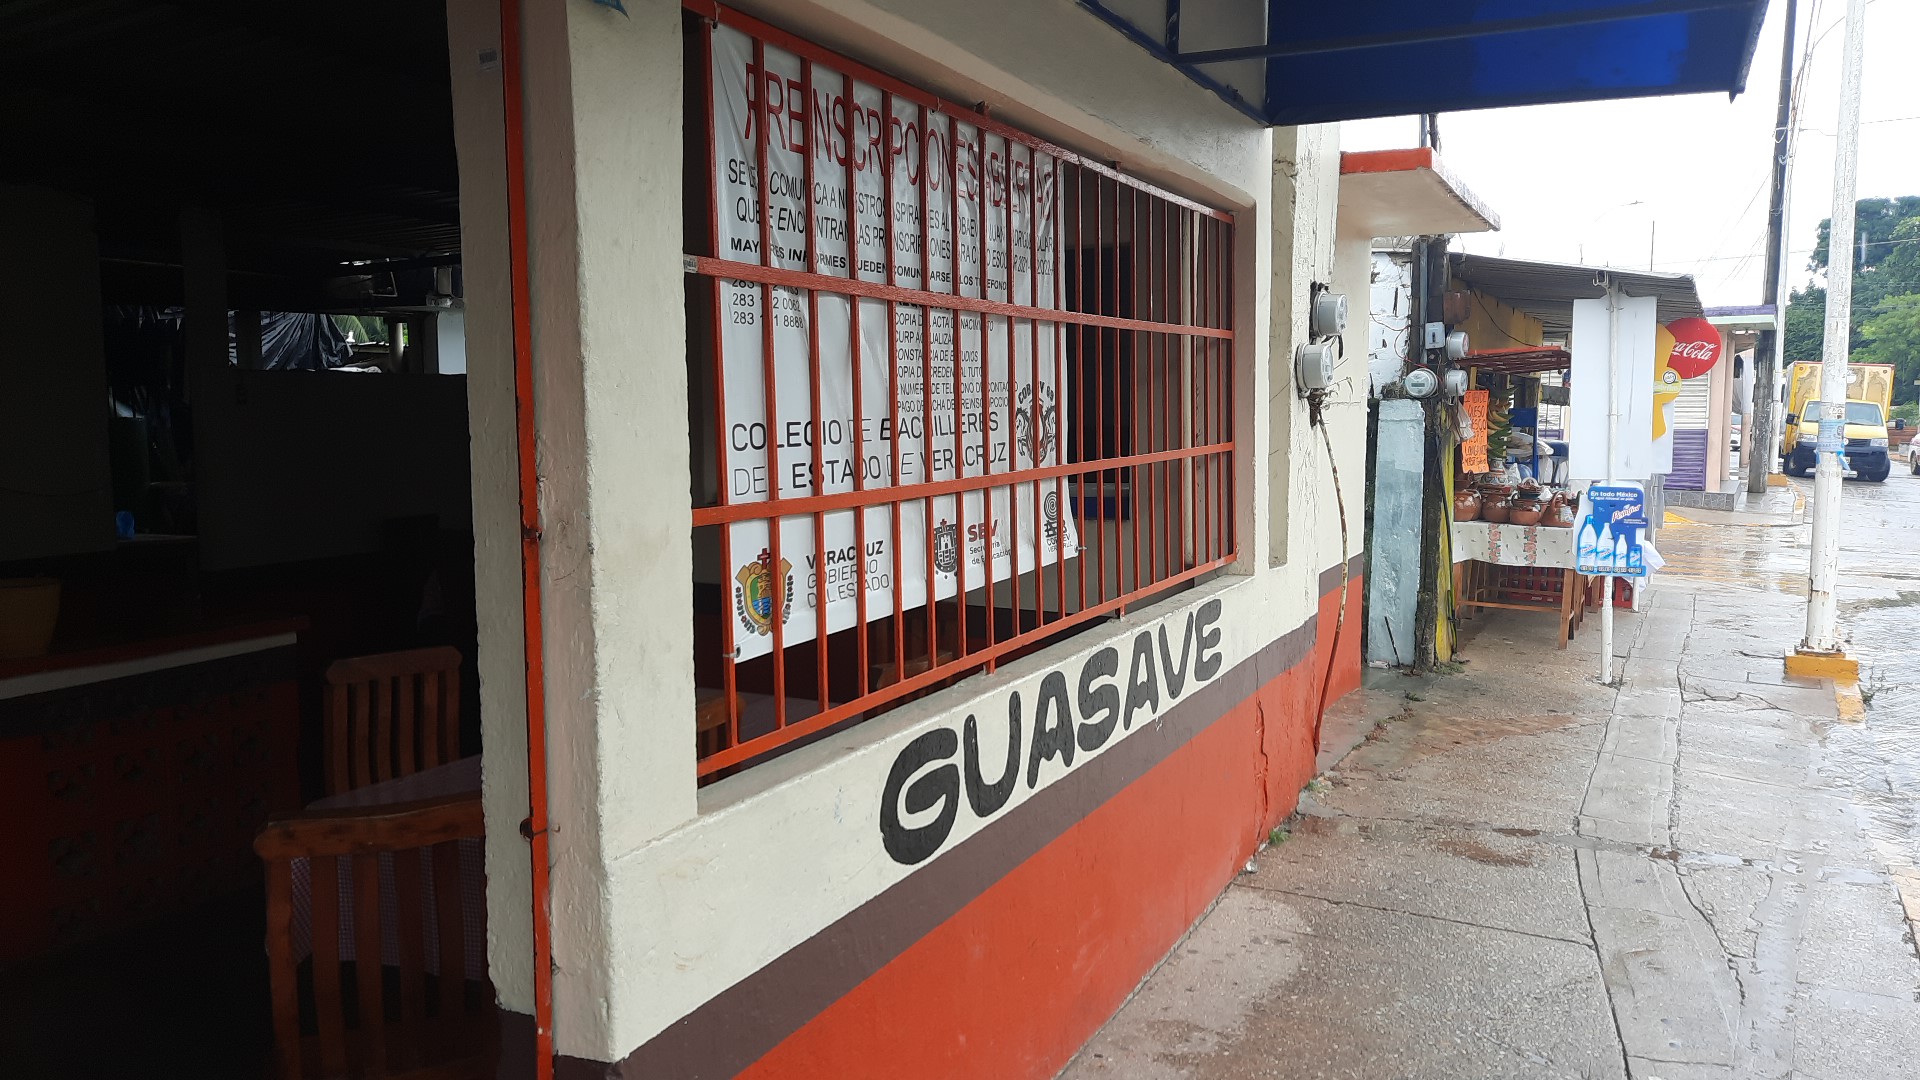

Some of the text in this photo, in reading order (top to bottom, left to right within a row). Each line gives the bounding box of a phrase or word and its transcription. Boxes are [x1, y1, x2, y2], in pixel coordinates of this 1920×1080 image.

[745, 62, 980, 202] PRENSCRPCONES
[729, 158, 746, 186] SE
[770, 170, 828, 208] COMUCA
[894, 200, 940, 231] SPIRAES
[777, 207, 849, 242] ENCNTRA
[731, 237, 785, 260] MAYRES
[788, 248, 846, 269] INFRMES
[857, 259, 887, 274] UEDEN
[894, 264, 952, 283] OMUNARSE
[974, 276, 1007, 291] TEFONO
[732, 293, 755, 307] 283
[733, 311, 755, 326] 283
[932, 317, 950, 329] ACTA
[897, 365, 915, 379] OPIA
[900, 382, 924, 396] NUMER
[732, 420, 842, 452] COEIO
[880, 411, 999, 441] BACILLERES
[734, 465, 783, 496] DE
[920, 441, 1007, 471] VERCRUZ
[1616, 490, 1638, 498] México
[806, 540, 884, 570] VRACUZ
[807, 559, 878, 589] GBIERO
[807, 573, 890, 608] DL ESADO
[880, 598, 1222, 865] GUASAVE
